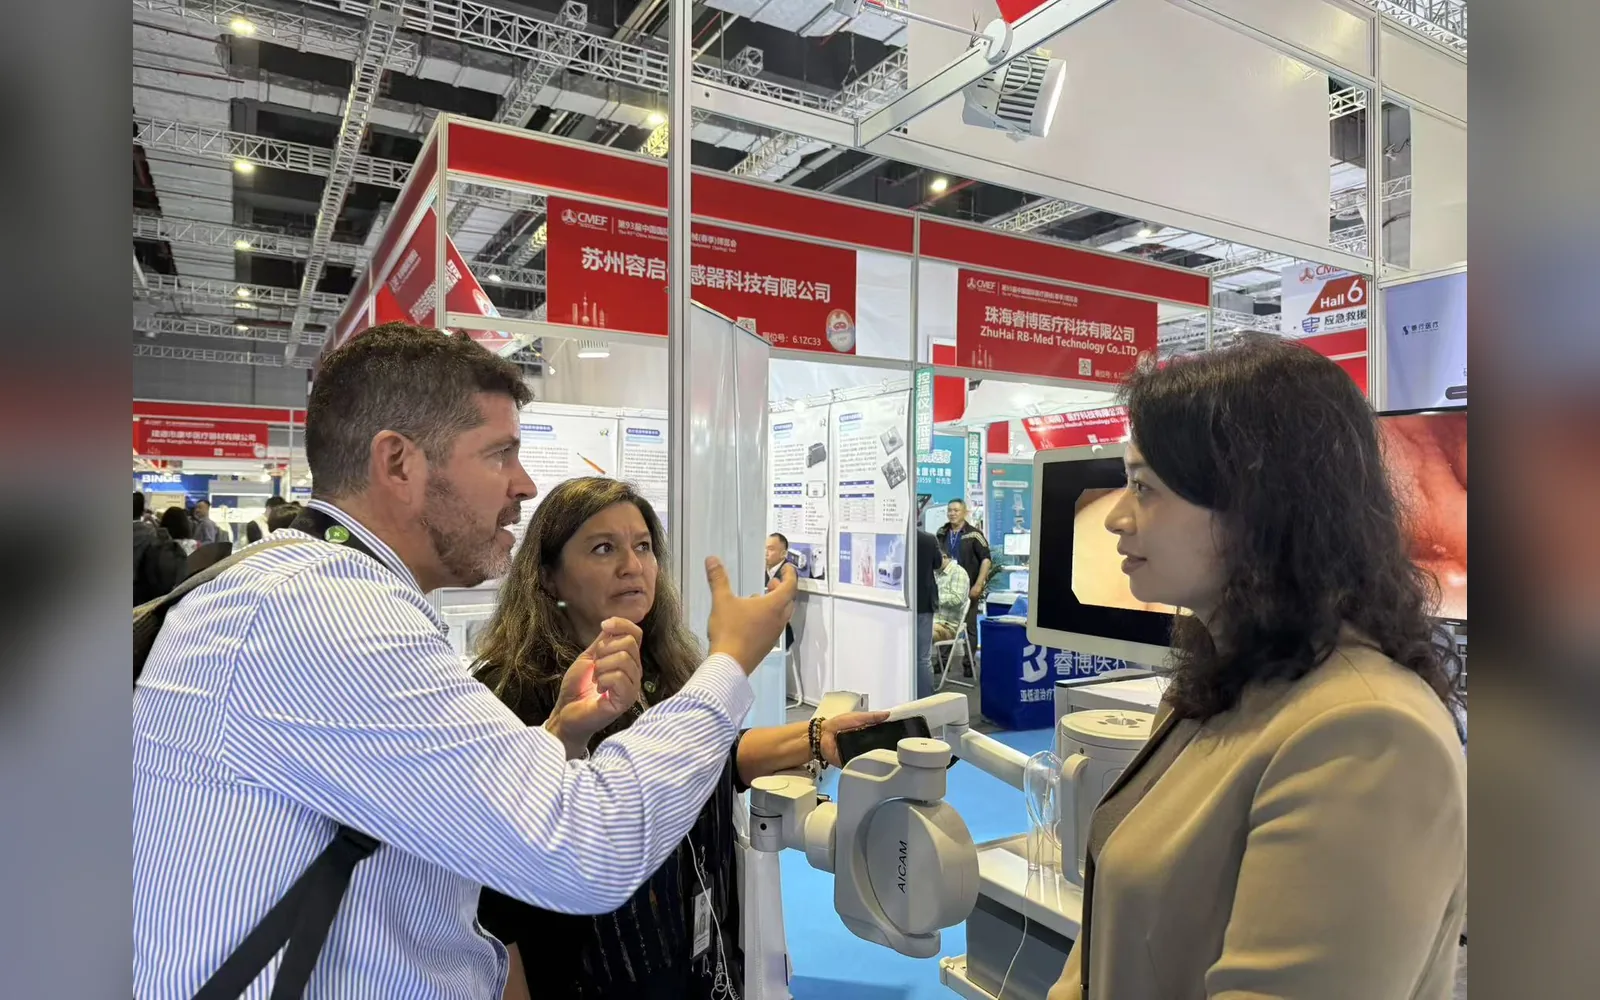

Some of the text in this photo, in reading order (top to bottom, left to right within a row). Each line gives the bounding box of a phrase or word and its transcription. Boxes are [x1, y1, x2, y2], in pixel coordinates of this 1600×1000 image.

[578, 212, 608, 226] CMEF
[580, 246, 831, 304] 苏州容启感器科技有限公司
[1320, 278, 1364, 309] Hall 6
[980, 325, 1014, 341] ZhuHai
[1017, 332, 1054, 346] RB-Med
[1056, 335, 1105, 355] Technology
[984, 305, 1135, 344] 珠海睿博医疗科技有限公司
[141, 474, 182, 484] BINGE
[897, 839, 908, 894] AICAM
